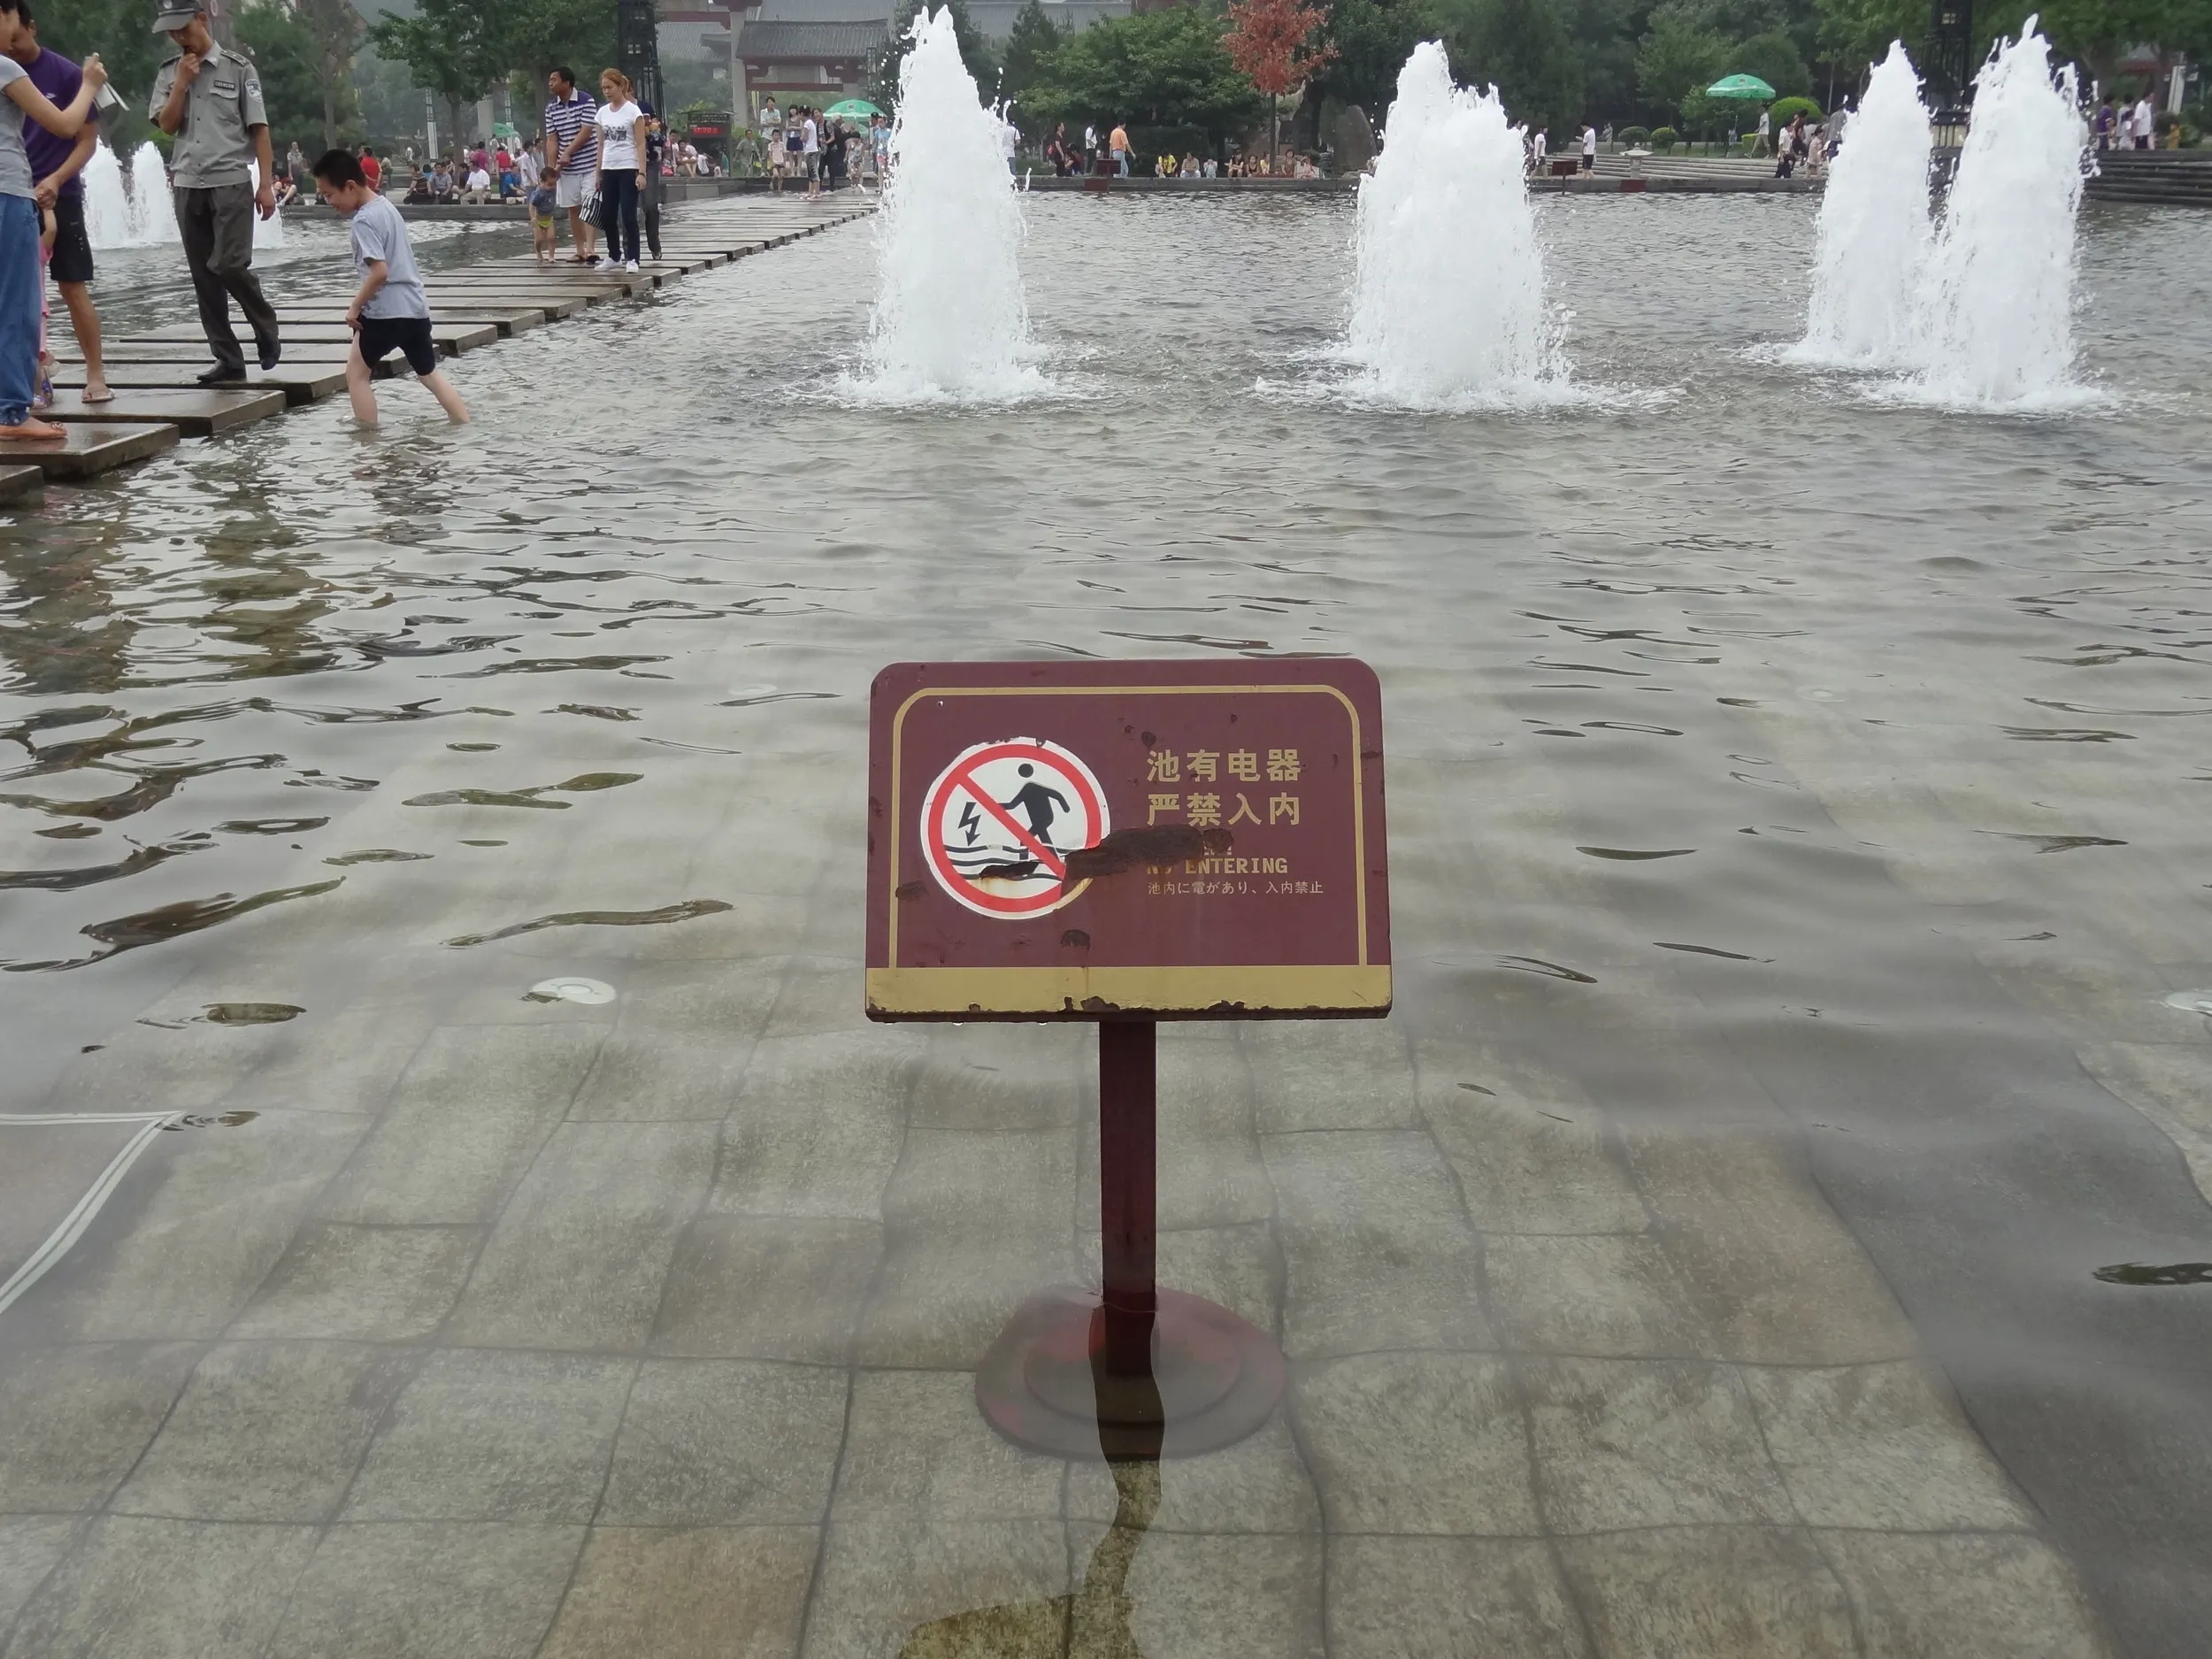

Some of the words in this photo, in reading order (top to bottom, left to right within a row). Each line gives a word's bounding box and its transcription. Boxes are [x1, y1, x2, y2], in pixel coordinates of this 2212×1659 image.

[1147, 749, 1302, 782] 池有电器
[1147, 792, 1301, 826] 严禁入内
[1185, 857, 1288, 874] ENTERING
